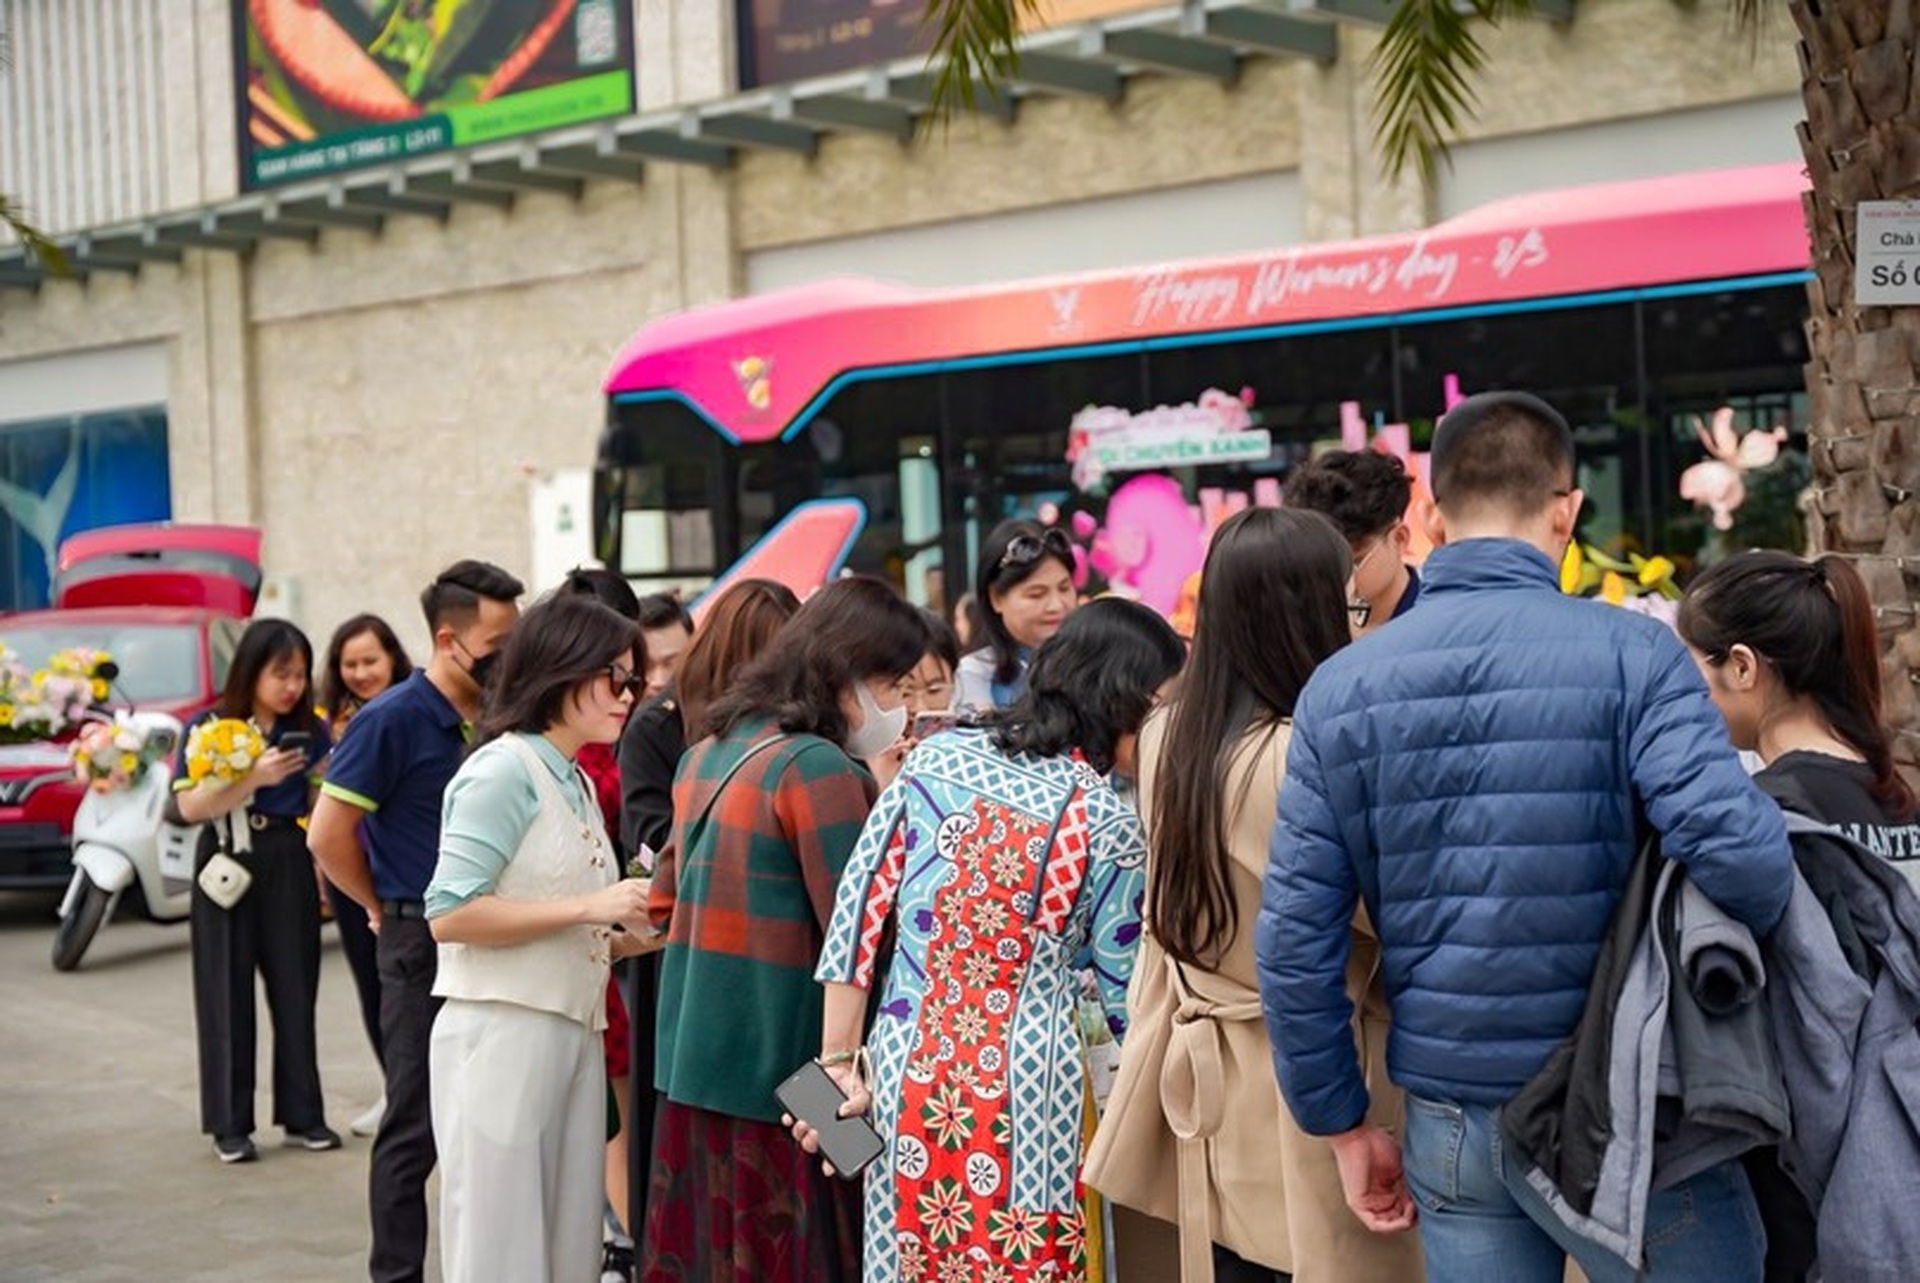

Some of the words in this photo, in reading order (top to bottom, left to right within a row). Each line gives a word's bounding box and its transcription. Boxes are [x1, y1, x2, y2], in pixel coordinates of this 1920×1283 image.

[1880, 232, 1915, 246] Chà
[1871, 259, 1907, 287] Số
[1132, 272, 1239, 327] Happy
